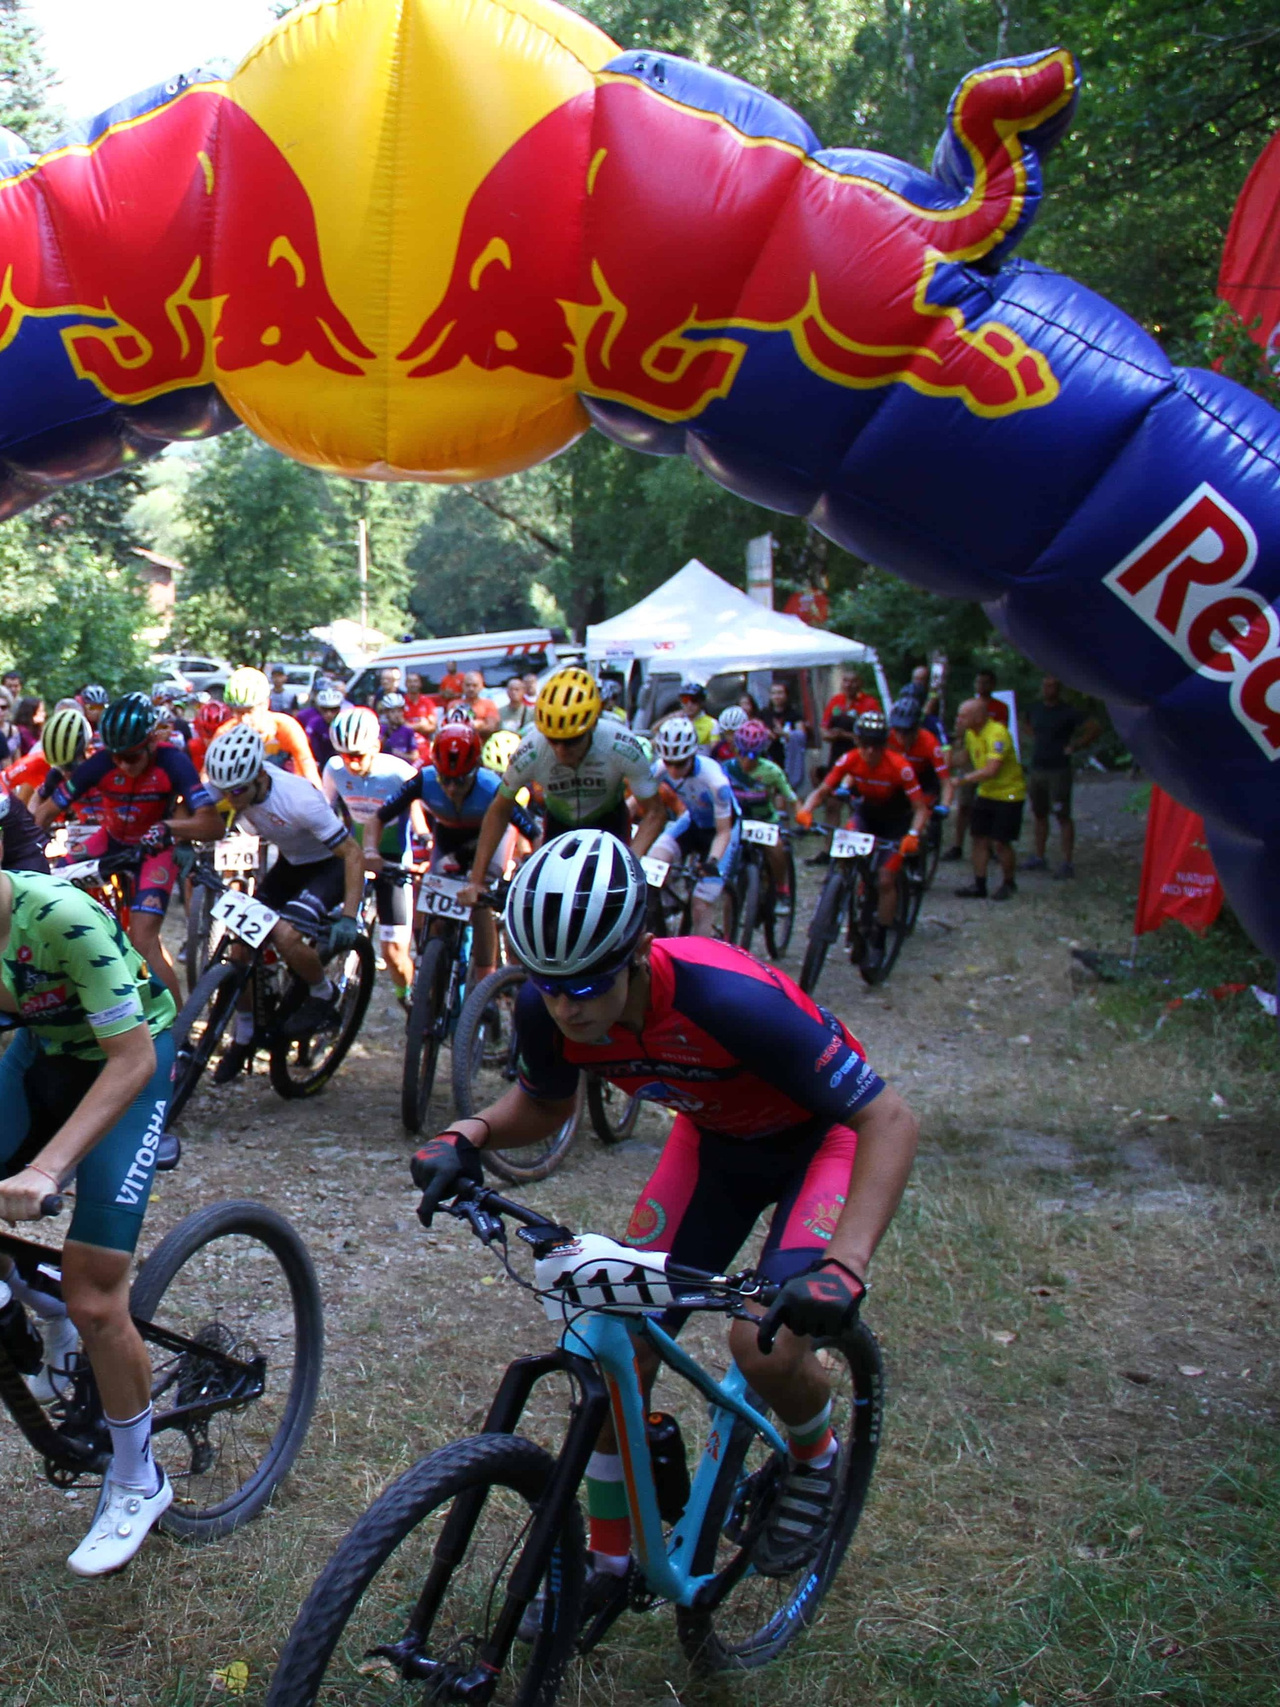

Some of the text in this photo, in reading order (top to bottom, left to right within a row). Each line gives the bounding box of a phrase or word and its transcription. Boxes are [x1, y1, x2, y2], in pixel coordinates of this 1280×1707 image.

[548, 777, 606, 792] BEROE
[223, 904, 261, 941] 112
[115, 1100, 166, 1205] VITOSHA
[552, 1264, 656, 1308] 111
